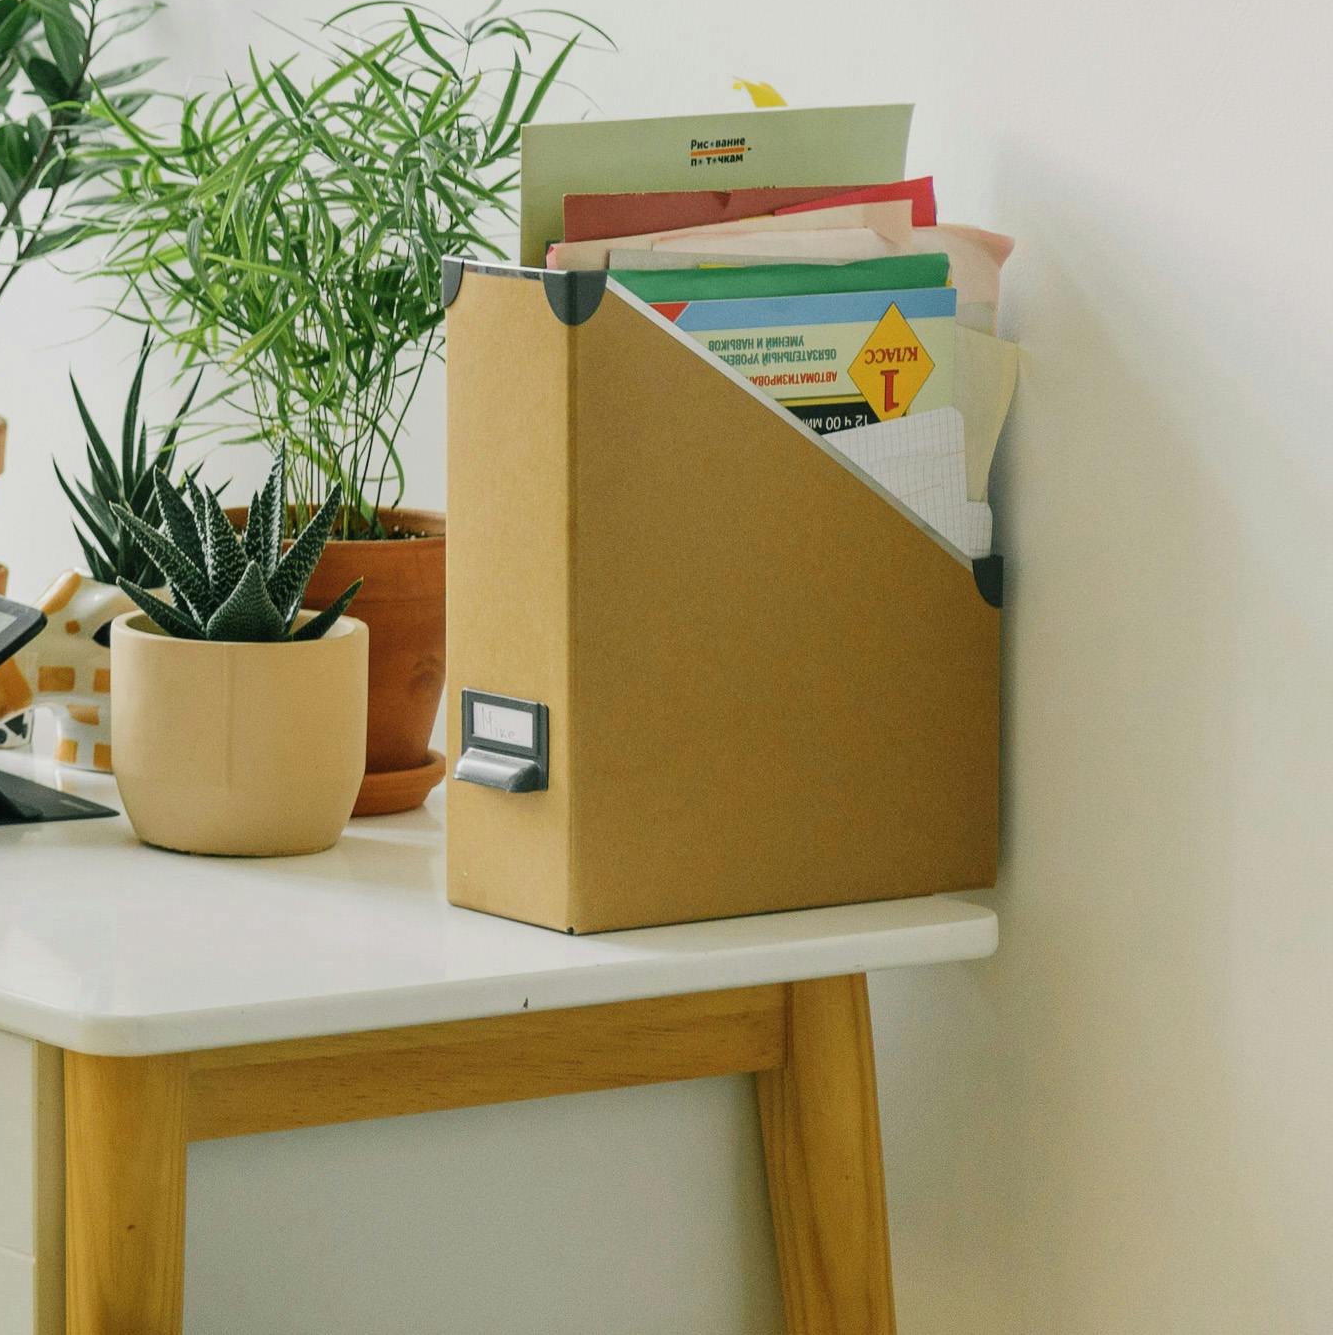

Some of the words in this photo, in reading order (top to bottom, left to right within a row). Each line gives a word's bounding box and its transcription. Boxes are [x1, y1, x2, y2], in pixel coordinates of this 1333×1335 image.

[708, 338, 754, 352] НАВЫКОВ
[756, 337, 763, 349] И
[765, 335, 804, 349] УМЕНИЙ
[718, 351, 759, 366] УРОВЕН
[762, 349, 837, 366] ОБЯЗАТЕЛЬНЫЙ
[864, 346, 918, 364] КЛАСС
[880, 369, 899, 412] 1
[802, 417, 823, 429] ми
[855, 414, 868, 427] 12
